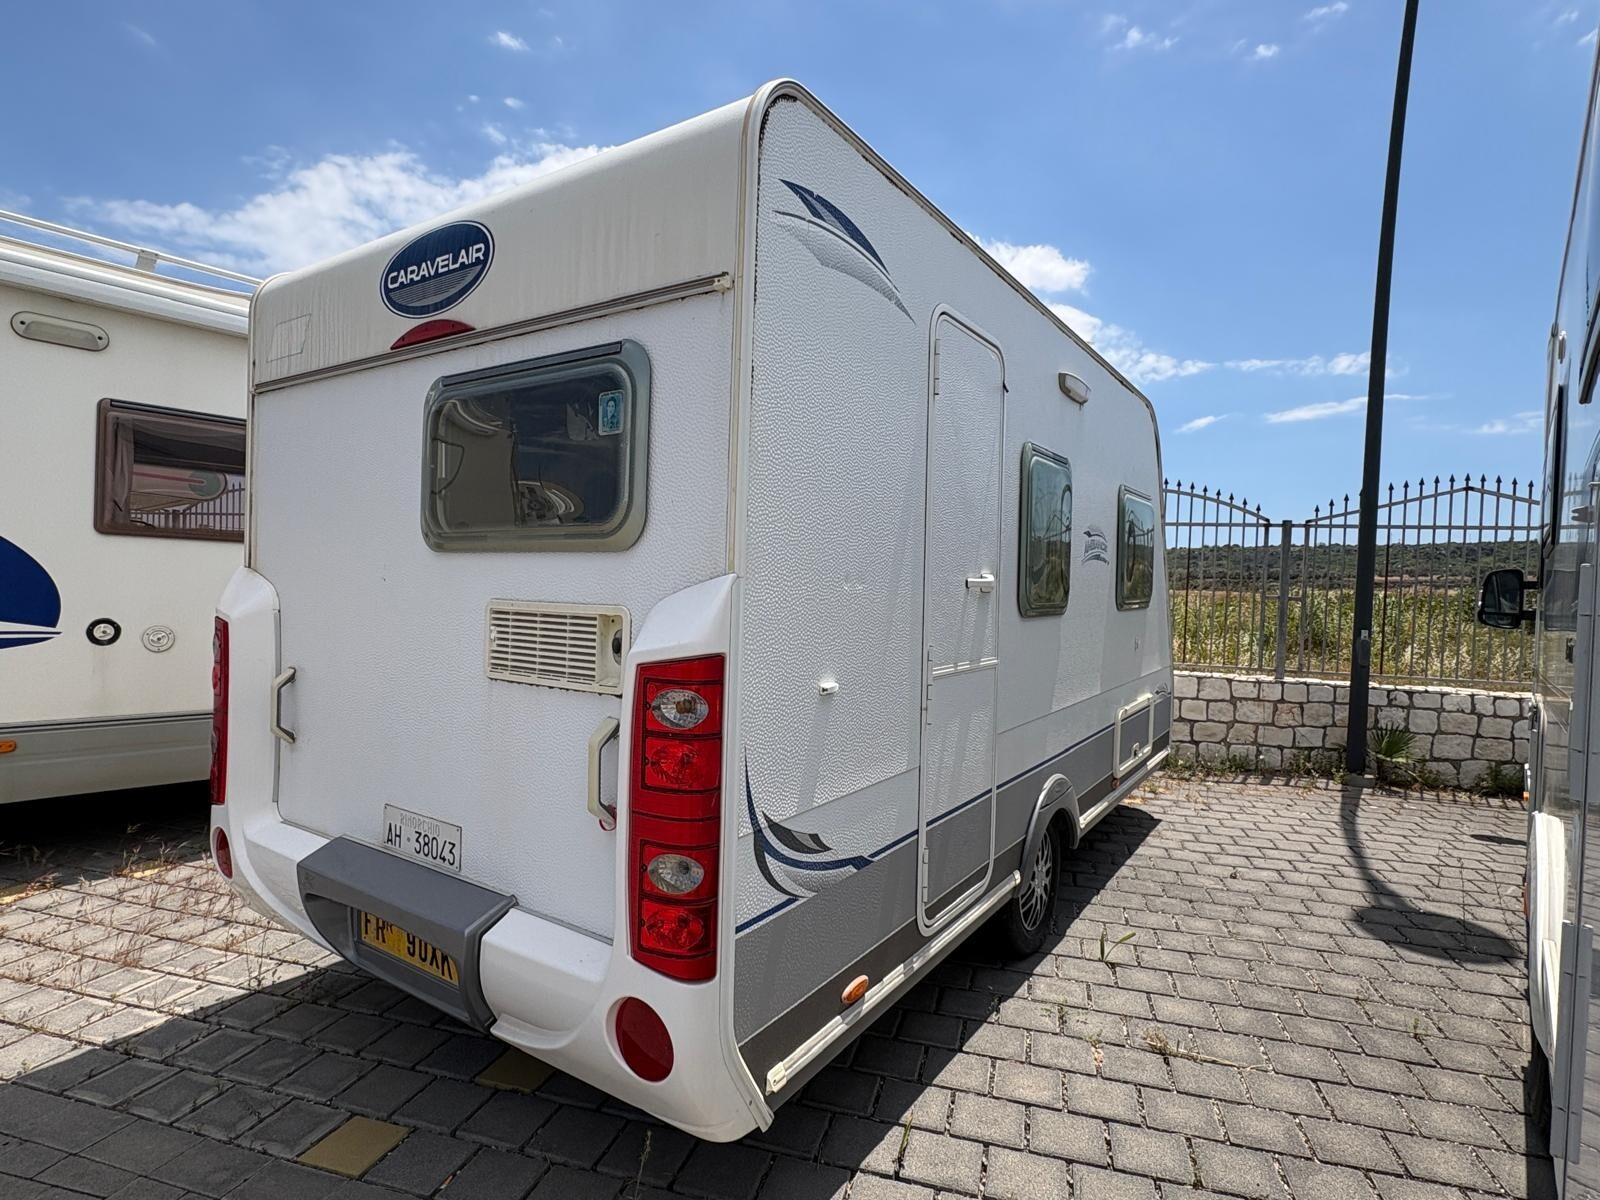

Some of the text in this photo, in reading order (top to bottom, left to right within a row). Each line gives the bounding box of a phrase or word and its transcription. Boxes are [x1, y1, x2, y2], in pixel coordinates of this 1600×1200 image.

[387, 242, 485, 289] CARAVELAIR
[386, 822, 457, 866] AH 38043
